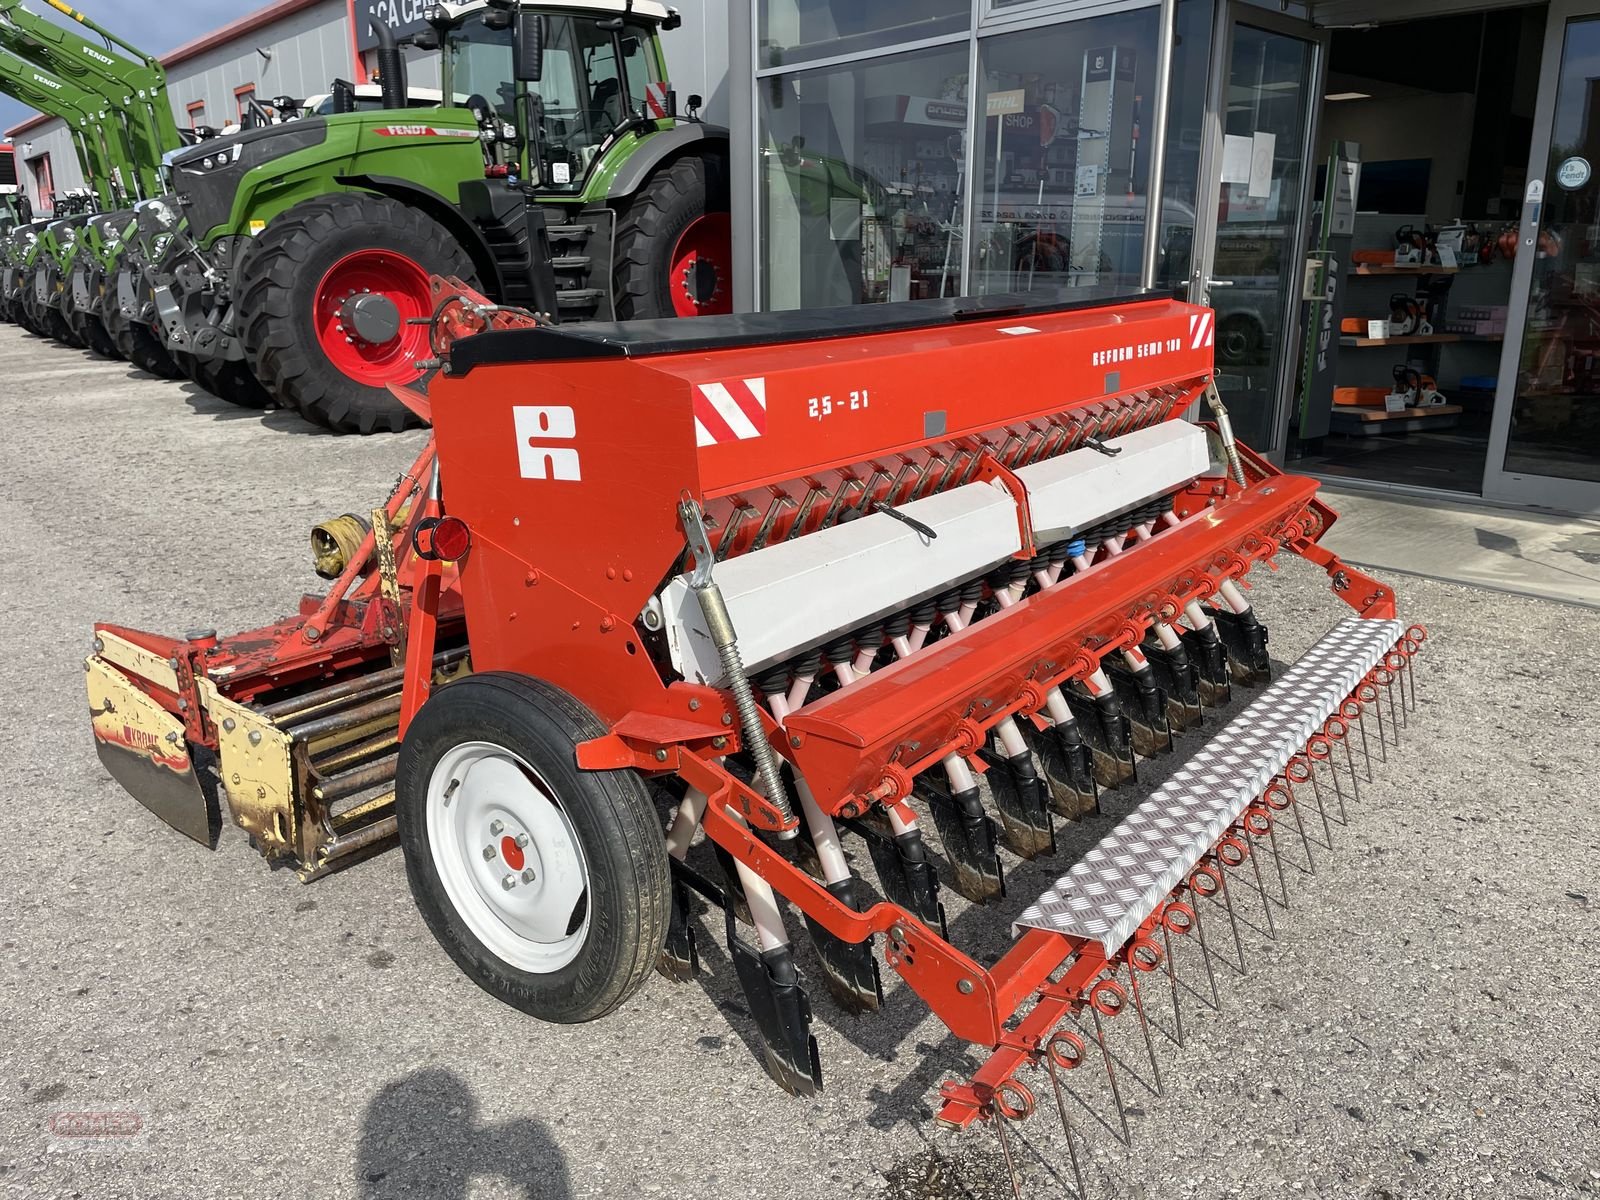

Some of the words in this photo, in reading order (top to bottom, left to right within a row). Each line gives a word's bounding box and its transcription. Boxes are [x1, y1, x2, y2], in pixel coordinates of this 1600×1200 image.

[82, 46, 115, 65] FENDT
[33, 74, 63, 90] FENDT
[1006, 114, 1033, 128] SHOP
[386, 125, 428, 135] FENDT
[1560, 171, 1585, 179] Fendt
[1092, 346, 1133, 366] REFORM
[1137, 341, 1162, 358] SEMO
[808, 396, 831, 421] 2,5
[849, 389, 869, 411] 21
